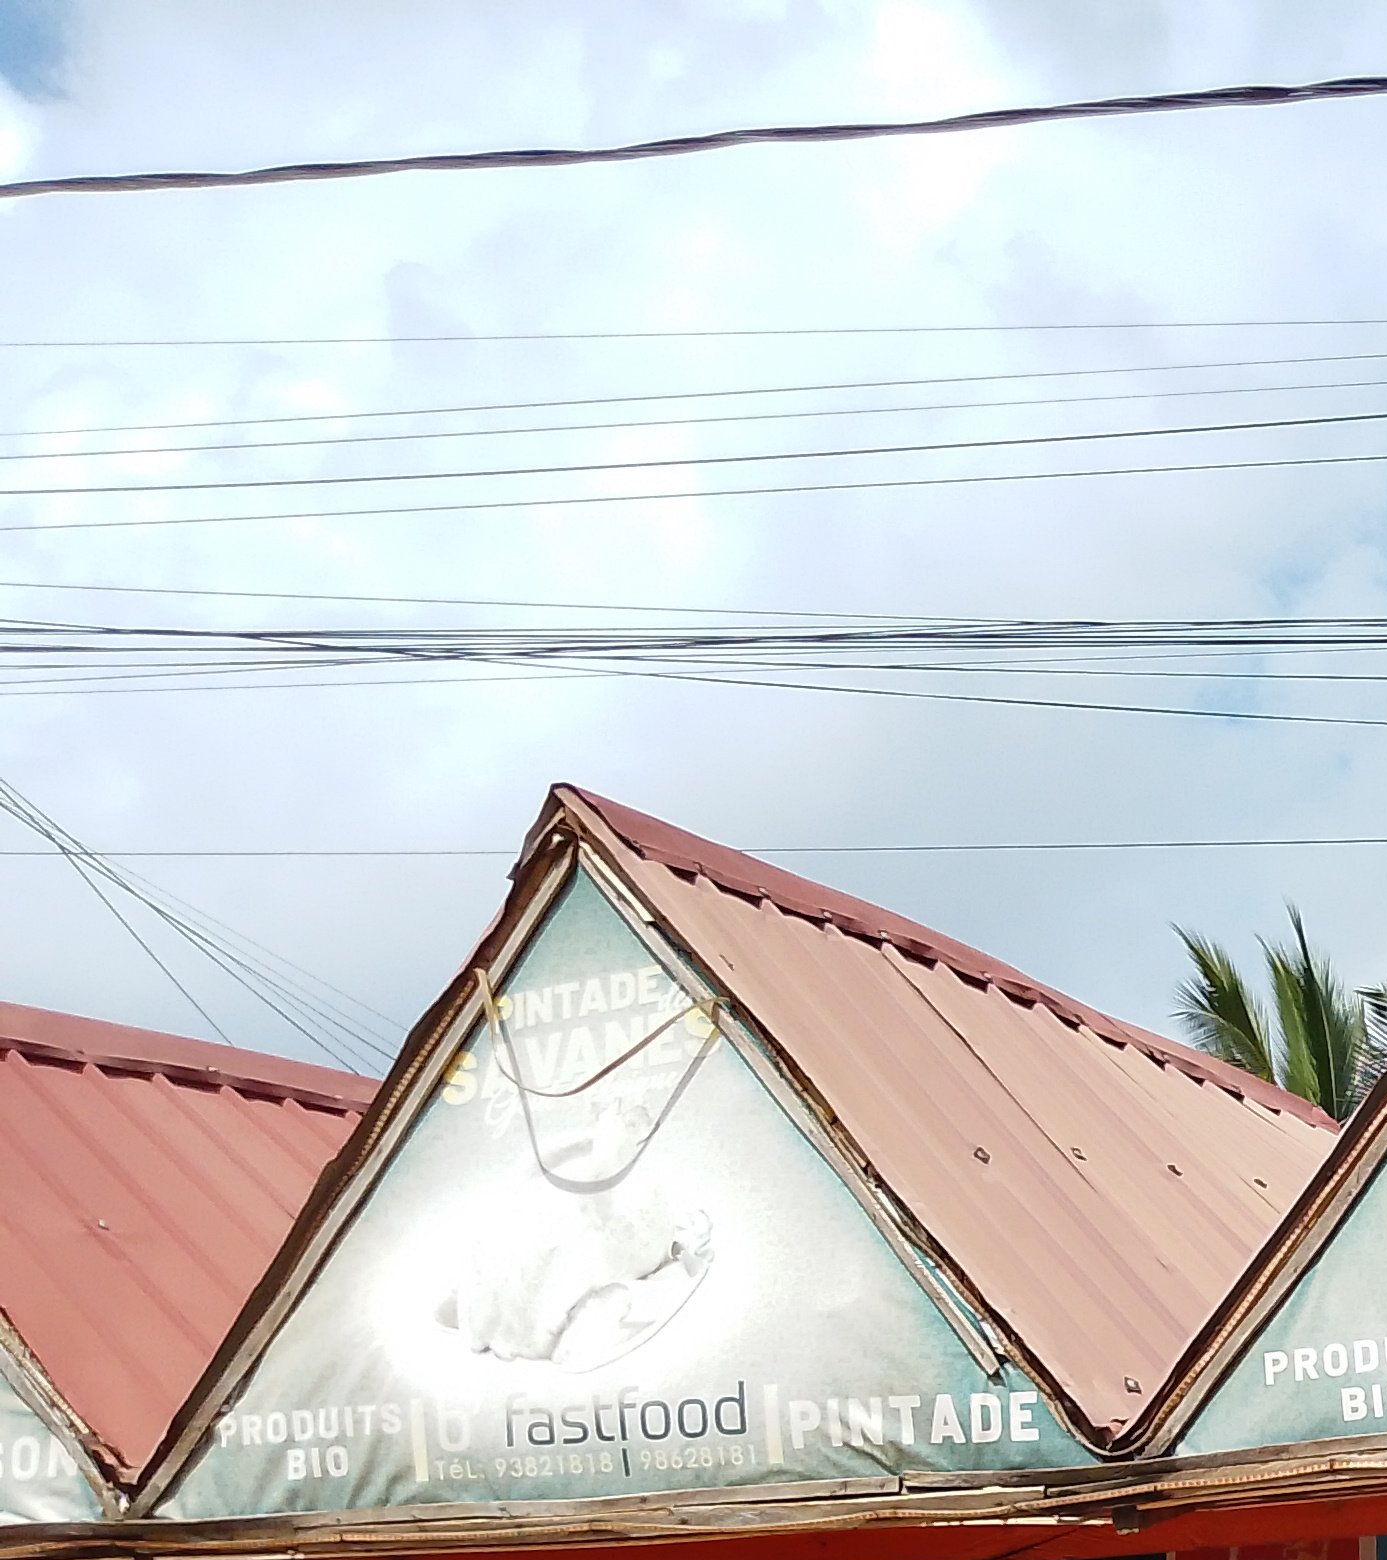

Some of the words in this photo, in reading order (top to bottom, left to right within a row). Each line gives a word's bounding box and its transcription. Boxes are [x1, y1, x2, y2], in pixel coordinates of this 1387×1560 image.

[494, 966, 665, 1034] PINTADE
[441, 1004, 723, 1107] SAVANES
[219, 1402, 403, 1448] PRODUITS
[505, 1380, 749, 1448] fastfood
[787, 1390, 1040, 1449] PINTADE
[0, 1434, 79, 1482] ON
[286, 1445, 351, 1482] BIO
[495, 1451, 614, 1480] 93821818
[641, 1443, 758, 1471] 98628181
